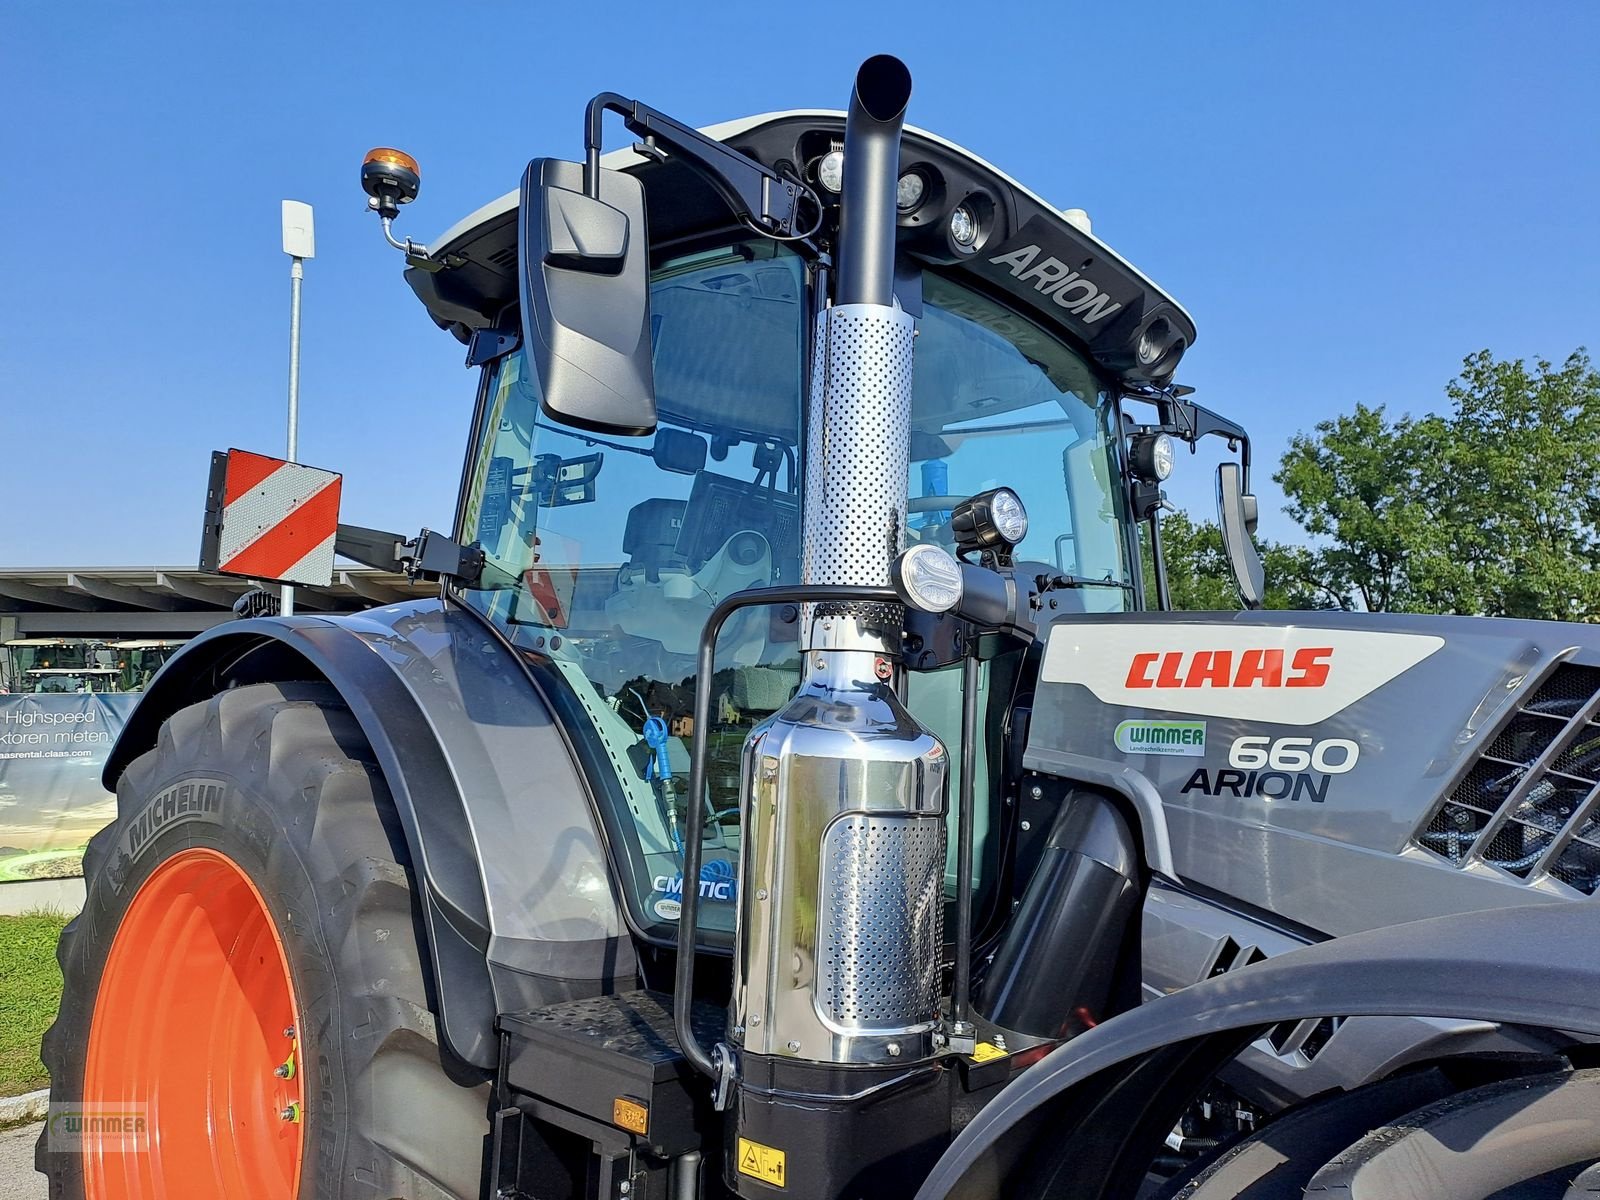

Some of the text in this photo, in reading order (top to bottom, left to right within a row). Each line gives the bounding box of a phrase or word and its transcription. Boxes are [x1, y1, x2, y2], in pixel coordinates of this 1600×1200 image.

[989, 244, 1122, 324] ARION
[1125, 648, 1334, 688] CLAAS
[5, 710, 96, 727] Highspeed
[55, 730, 112, 743] mieten.
[1129, 745, 1185, 753] Landtechnikzentrum
[1130, 728, 1203, 745] WIMMER
[1229, 736, 1360, 773] 660
[1181, 769, 1332, 802] ARION
[129, 784, 225, 856] MICHELIN
[653, 875, 730, 900] CMTIC
